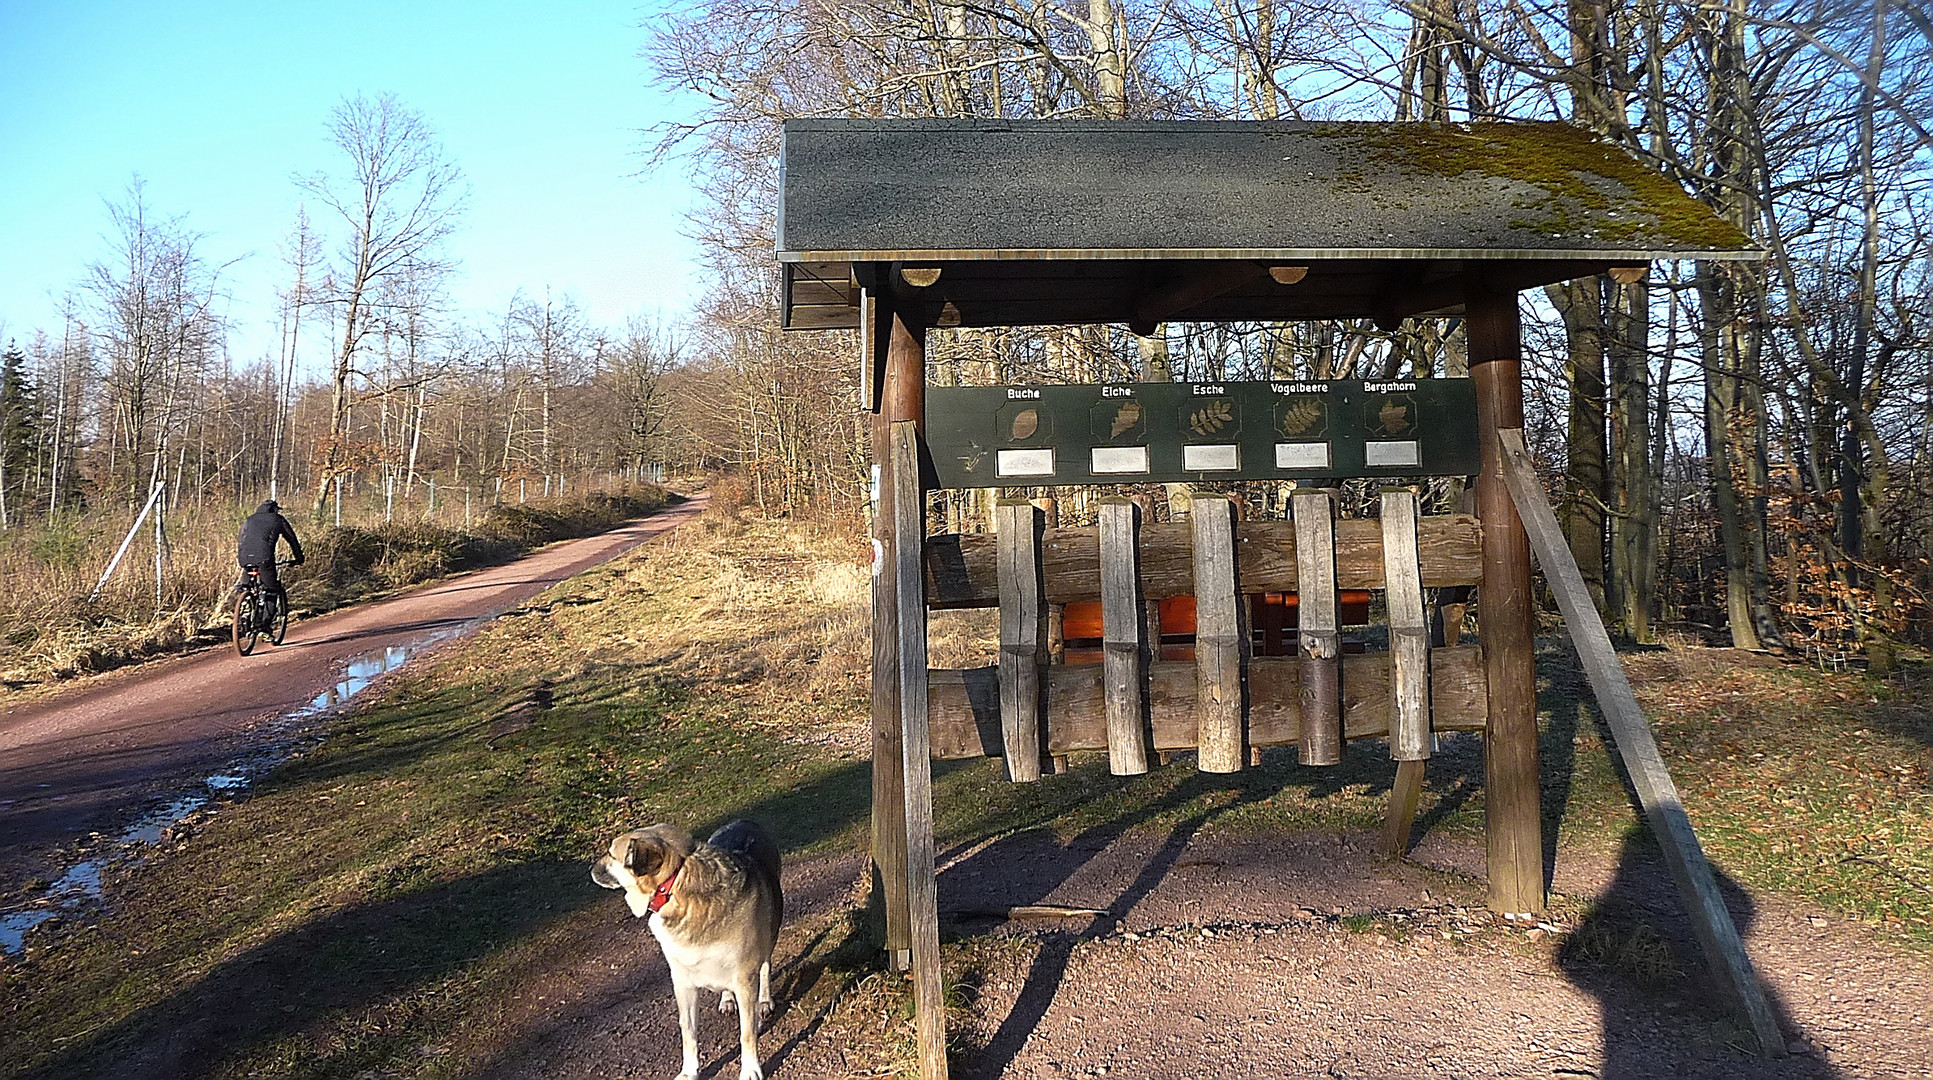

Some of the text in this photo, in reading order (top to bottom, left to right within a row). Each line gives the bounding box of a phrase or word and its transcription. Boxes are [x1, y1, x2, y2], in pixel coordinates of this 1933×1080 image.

[1007, 388, 1041, 399] Buche
[1193, 384, 1225, 395] Esche
[1270, 383, 1329, 396] Vogelbeere
[1363, 381, 1417, 394] Bergahorn
